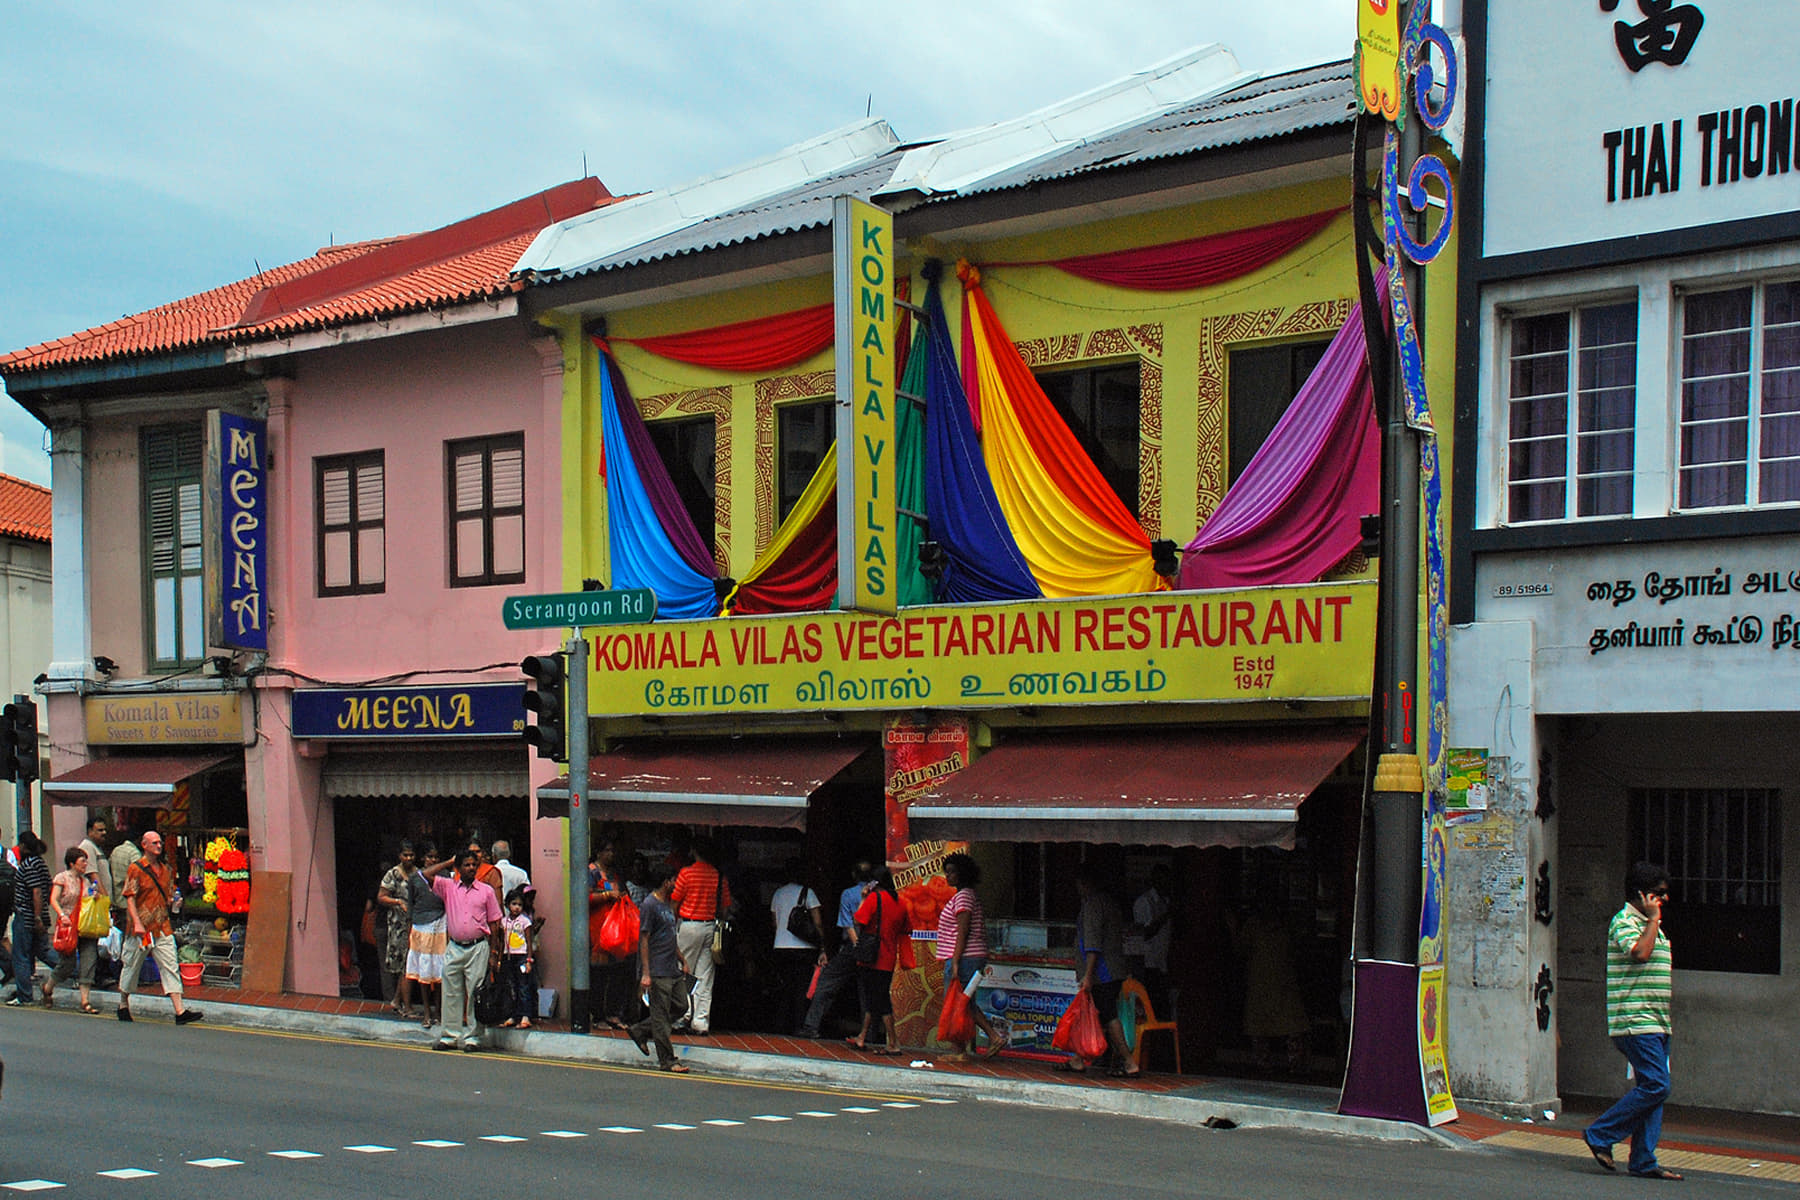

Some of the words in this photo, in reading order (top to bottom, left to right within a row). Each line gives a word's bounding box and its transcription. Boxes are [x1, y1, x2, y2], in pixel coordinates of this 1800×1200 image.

[1603, 119, 1682, 203] THAI
[1698, 97, 1800, 187] THON
[861, 219, 886, 421] KOMALA
[863, 433, 887, 597] VILAS
[1499, 584, 1548, 595] 89/51964
[1587, 580, 1637, 607] தை
[1644, 567, 1731, 606] தோங்
[513, 600, 612, 623] Serangoon
[621, 593, 643, 614] Rd
[595, 630, 721, 672] KOMALA
[730, 623, 823, 666] VILAS
[834, 610, 1061, 661] VEGETARIAN
[1074, 596, 1352, 652] RESTAURANT
[1589, 618, 1685, 656] தனியார்
[1693, 615, 1762, 645] கூட்டு
[1233, 655, 1275, 672] Estd
[645, 679, 770, 708] கோமள
[796, 668, 931, 703] விலாஸ்
[960, 659, 1167, 697] உணவகம்
[1234, 674, 1274, 690] 1947
[104, 701, 169, 723] Komala
[175, 699, 220, 721] Vilas
[337, 693, 475, 731] MEENA
[513, 720, 525, 731] 80
[107, 726, 144, 740] Sweets
[150, 725, 159, 739] &
[165, 725, 218, 739] Savouries
[573, 794, 580, 807] 3
[893, 867, 918, 890] APPY
